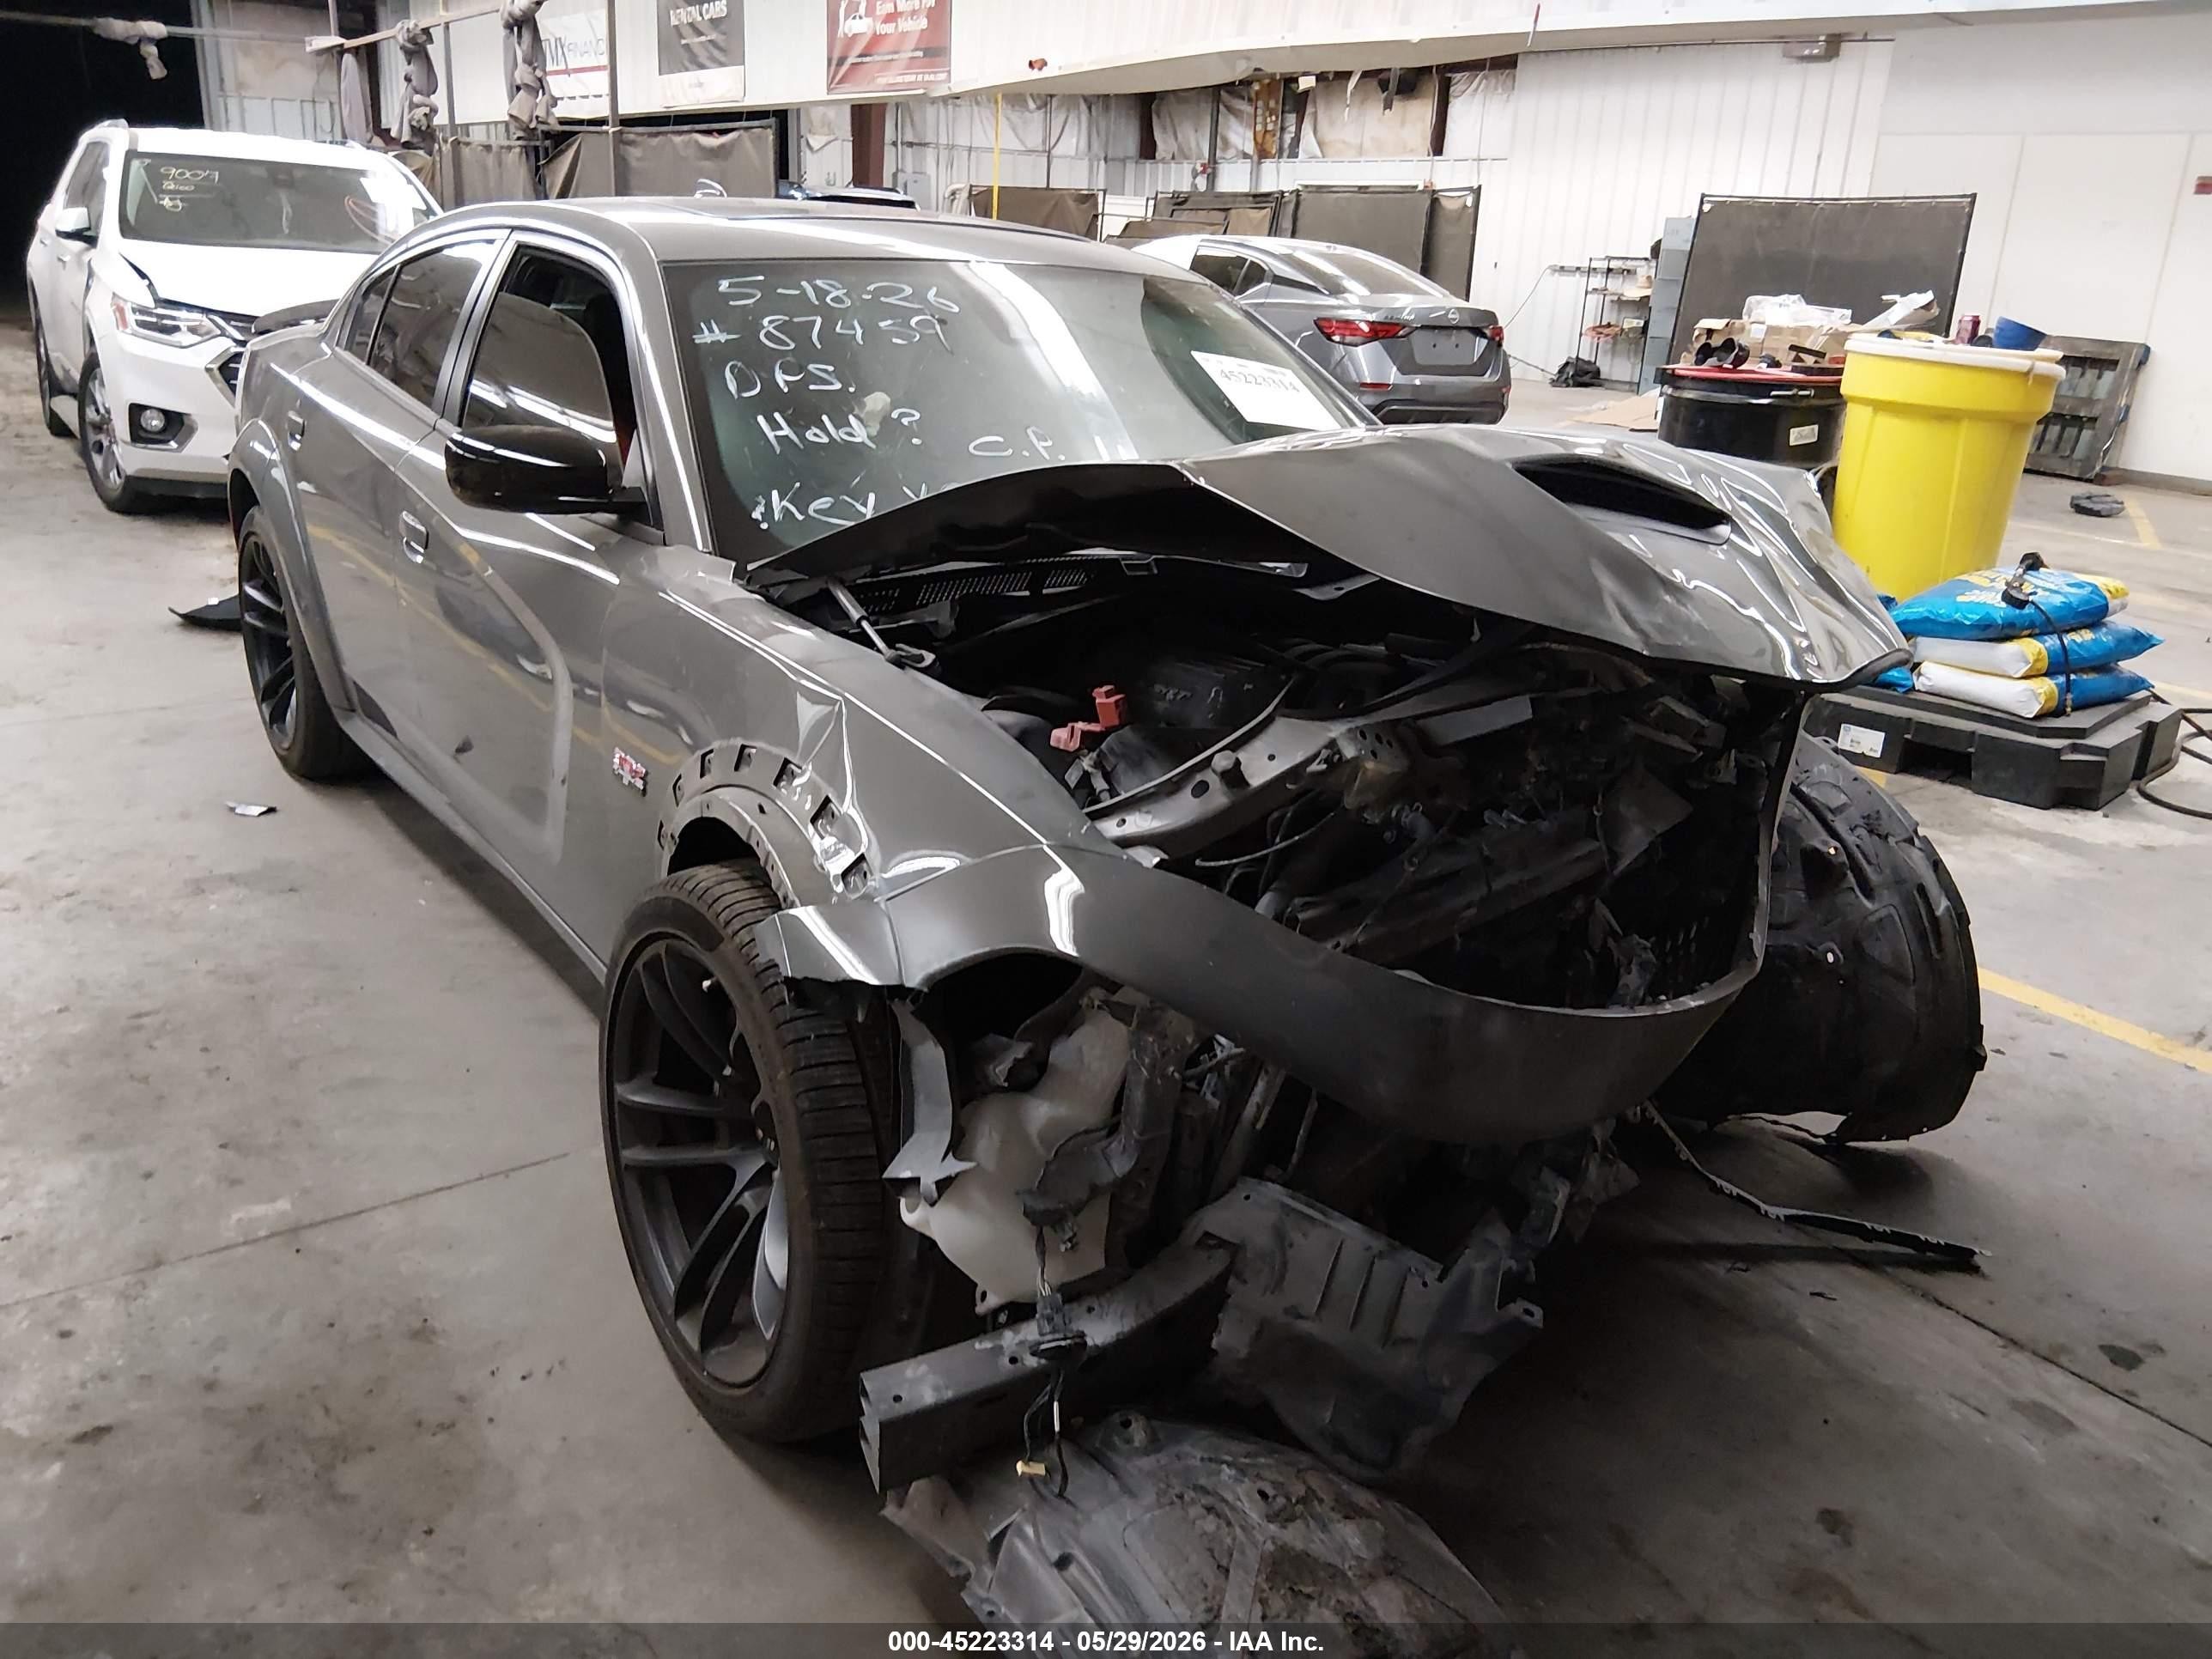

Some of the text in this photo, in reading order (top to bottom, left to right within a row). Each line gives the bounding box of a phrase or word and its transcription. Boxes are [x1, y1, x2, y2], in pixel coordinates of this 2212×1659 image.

[702, 0, 728, 20] CARS
[875, 21, 896, 35] Your
[757, 411, 877, 454] Hold
